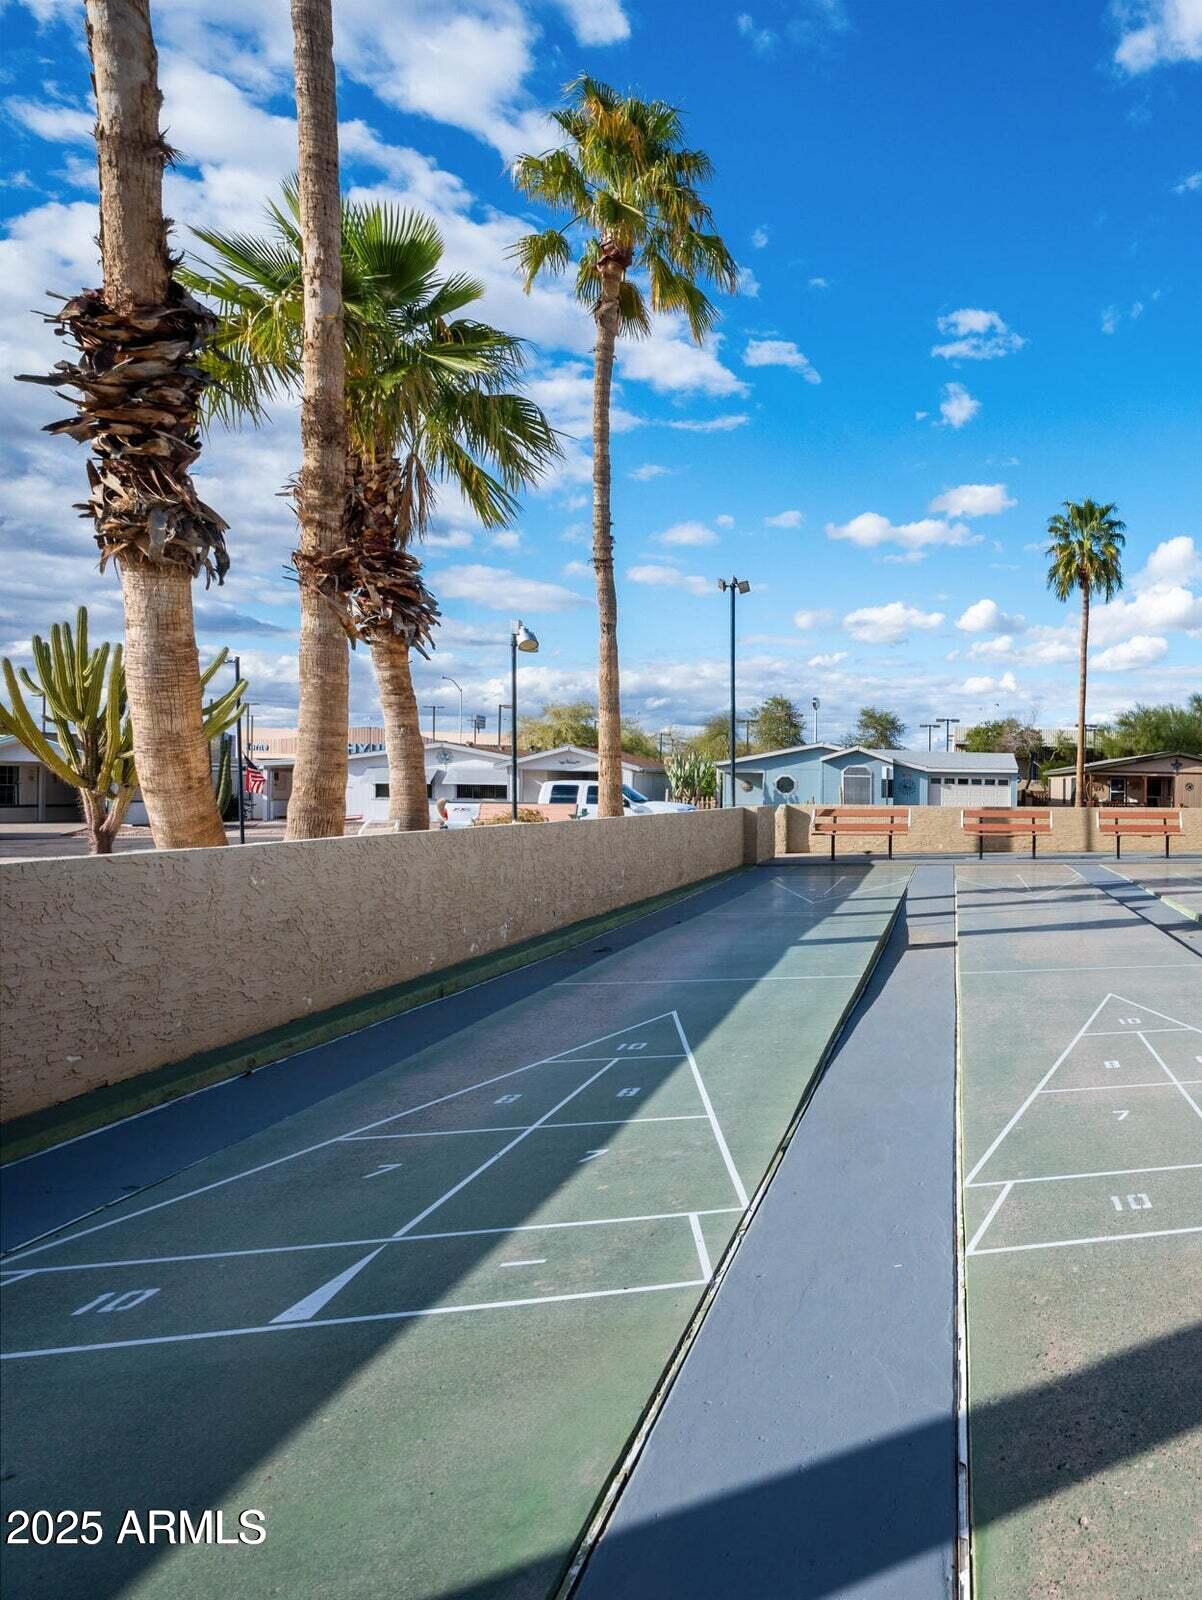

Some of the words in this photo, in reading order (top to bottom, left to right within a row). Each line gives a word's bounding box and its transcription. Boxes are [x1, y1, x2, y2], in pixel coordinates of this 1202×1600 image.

[1118, 1017, 1141, 1026] 10
[617, 1041, 648, 1051] 10
[1103, 1059, 1121, 1070] 8
[616, 1086, 641, 1098] 8
[1111, 1109, 1130, 1121] 7
[578, 1148, 609, 1163] 7
[363, 1163, 403, 1179] 7
[1110, 1193, 1153, 1211] 10
[69, 1287, 162, 1317] 10
